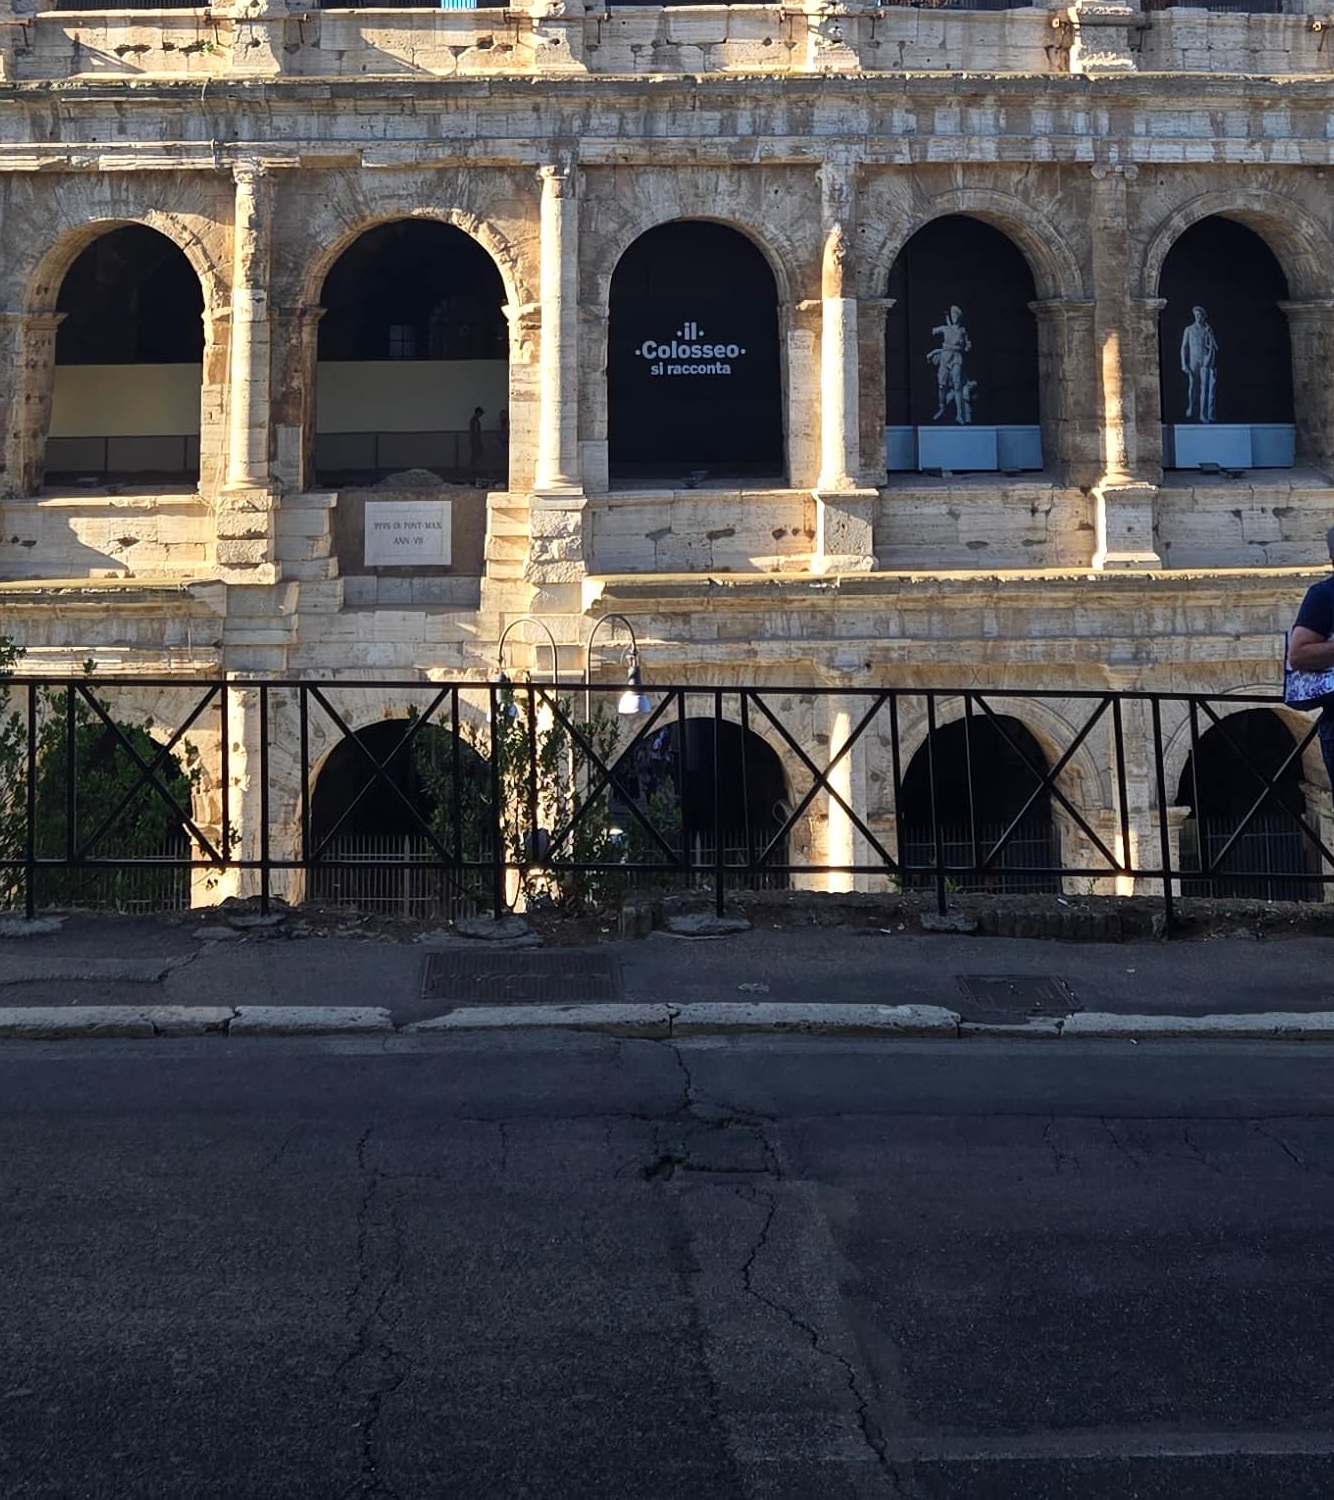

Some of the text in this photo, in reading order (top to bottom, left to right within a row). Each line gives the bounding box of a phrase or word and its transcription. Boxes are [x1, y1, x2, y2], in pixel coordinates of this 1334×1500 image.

[684, 322, 697, 340] il
[642, 340, 739, 359] Colosseo
[651, 362, 731, 375] si racconta
